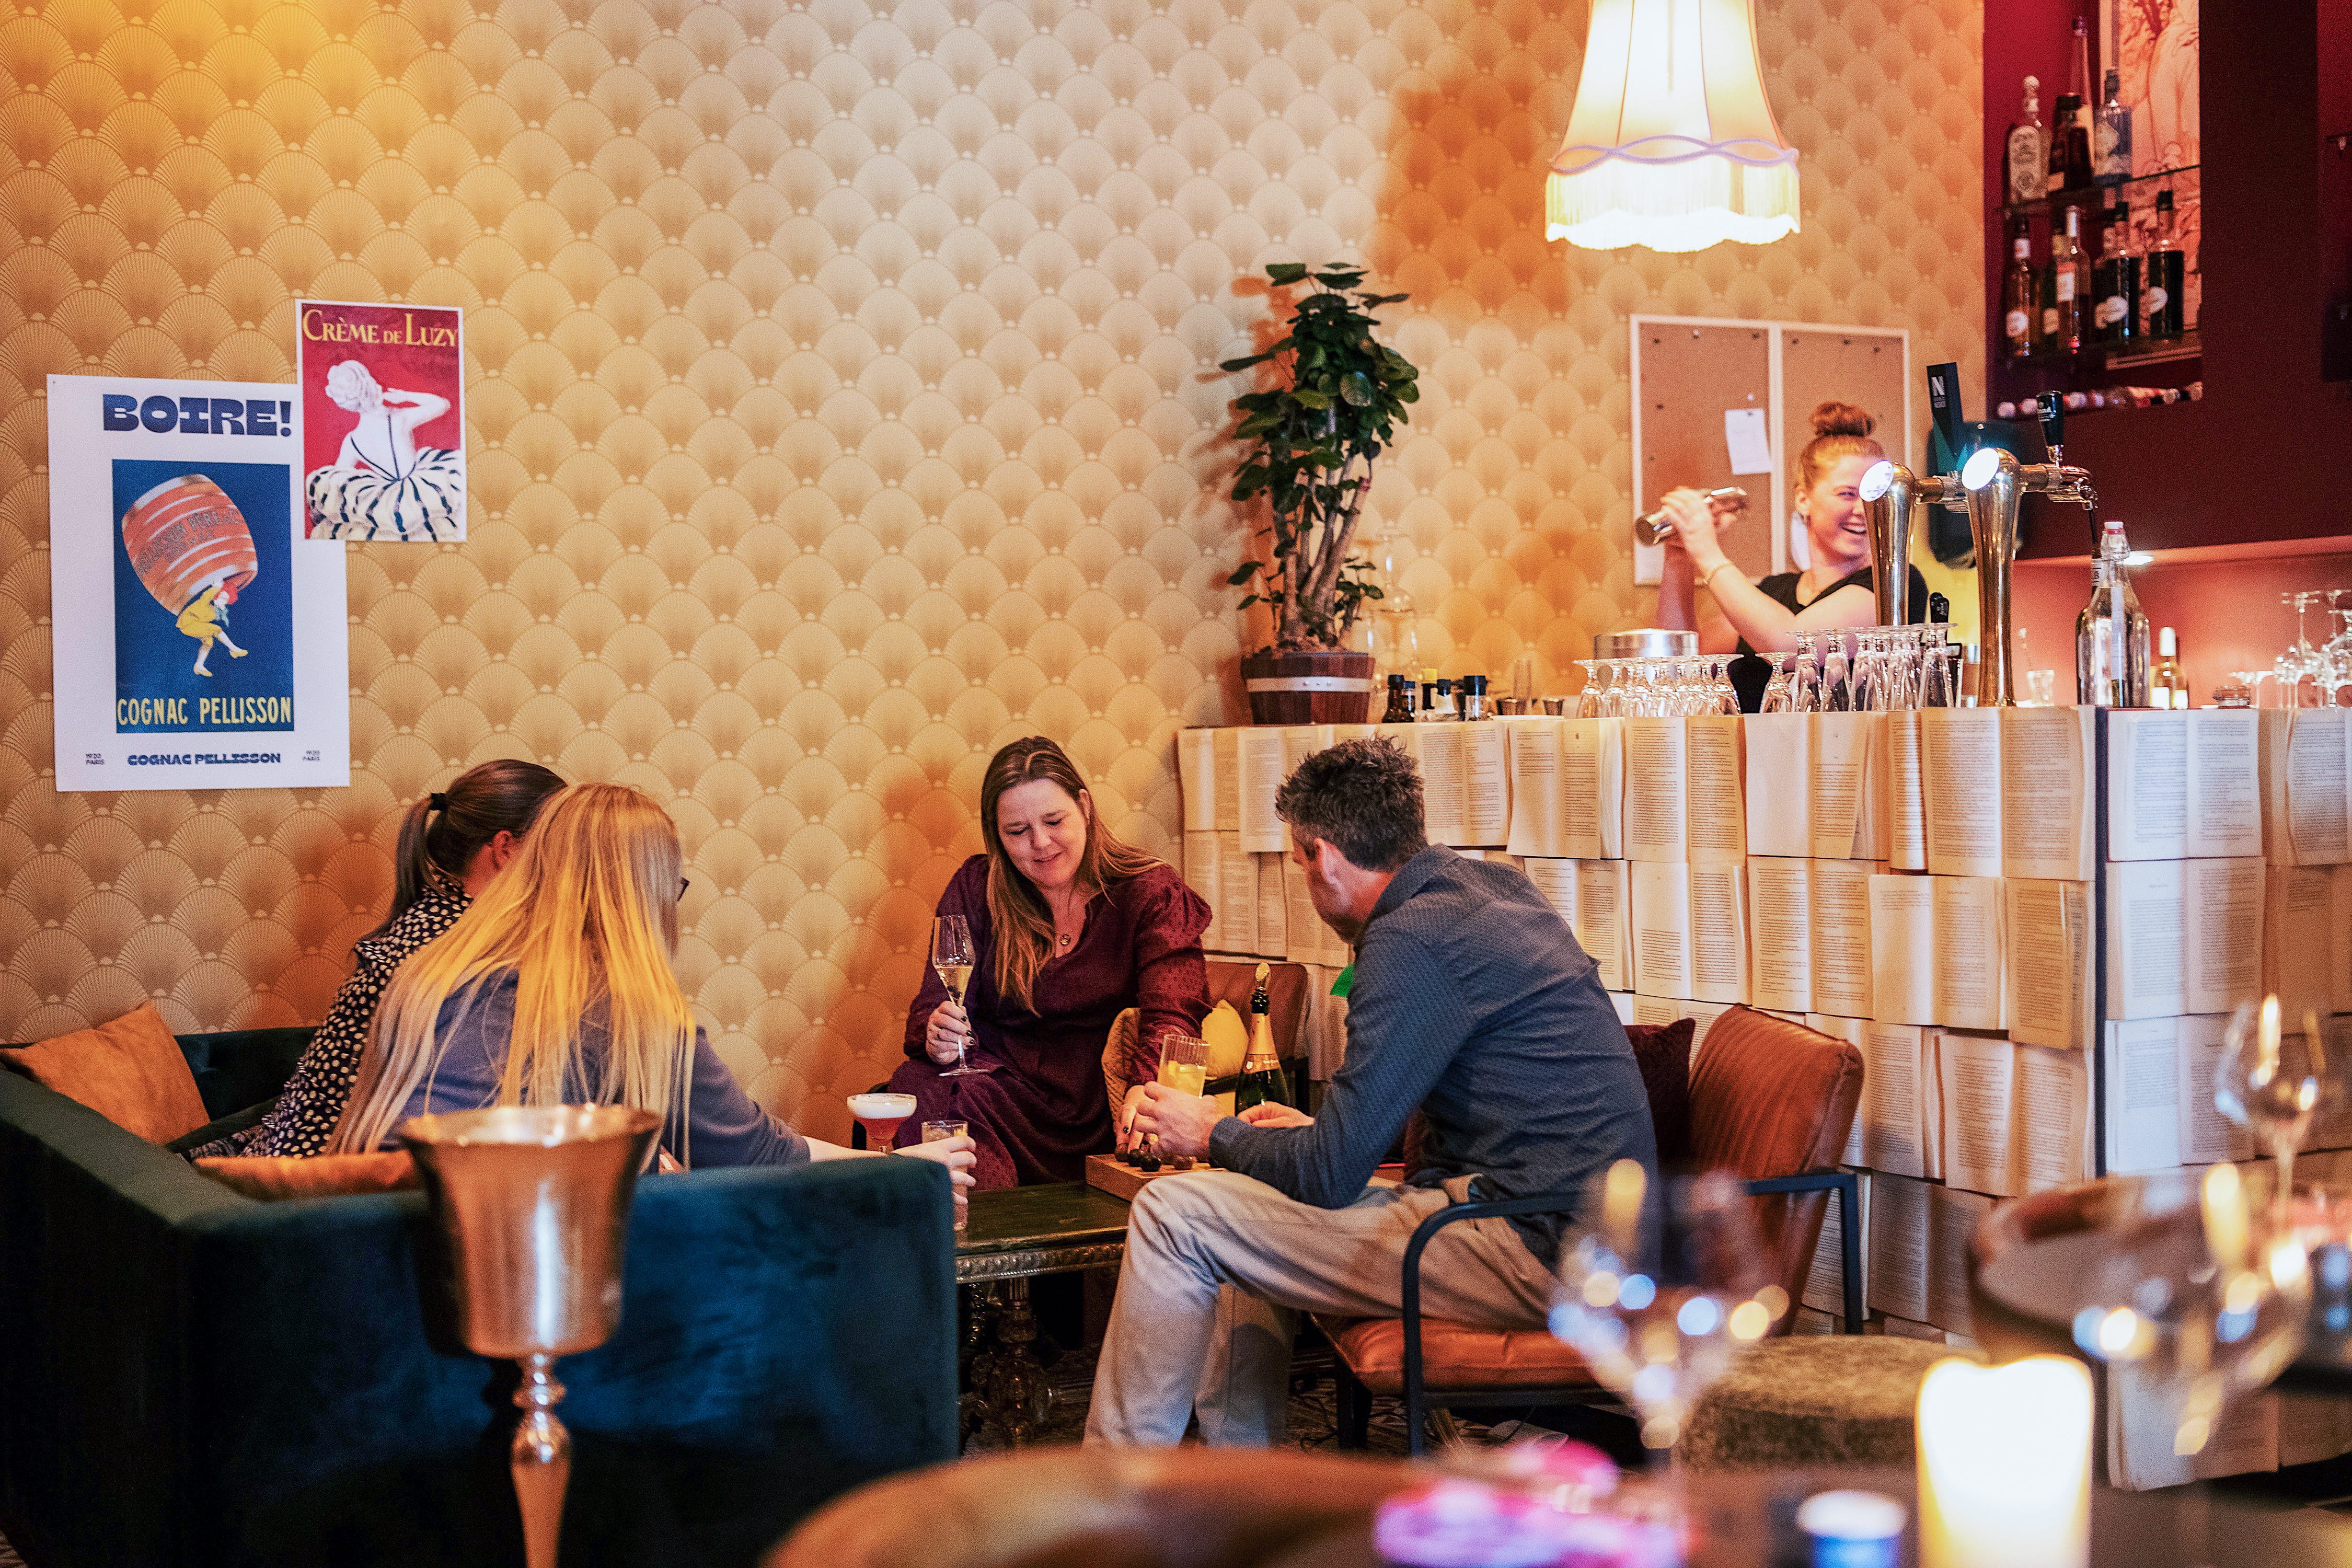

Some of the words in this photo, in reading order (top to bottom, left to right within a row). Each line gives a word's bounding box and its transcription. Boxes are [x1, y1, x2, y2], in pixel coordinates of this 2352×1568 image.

[1931, 375, 1946, 397] N
[102, 394, 292, 437] BOIRE!
[117, 698, 188, 725] COGNAC
[199, 696, 291, 724] PELLISSON
[127, 754, 192, 766] COGNAC
[194, 753, 281, 764] PELLISSON
